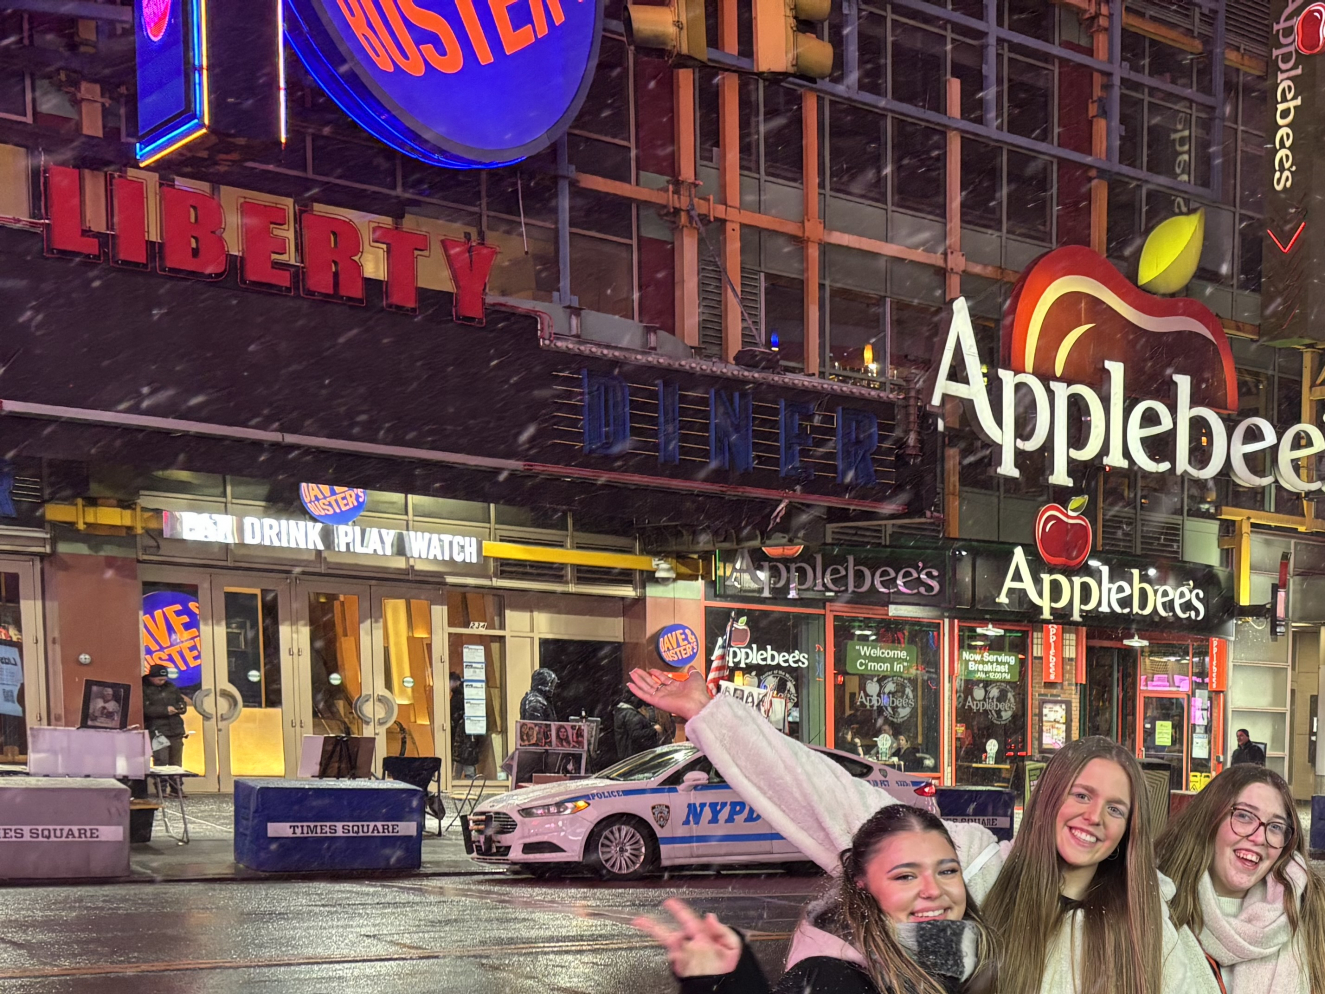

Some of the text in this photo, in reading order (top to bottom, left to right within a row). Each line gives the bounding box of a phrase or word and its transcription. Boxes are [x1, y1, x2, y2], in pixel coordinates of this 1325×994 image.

[44, 163, 499, 326] LIBERTY
[581, 368, 878, 488] DINER
[244, 518, 325, 551] DRINK
[336, 524, 397, 557] PLAY
[408, 530, 477, 563] WATCH
[725, 546, 941, 599] Applebee's
[996, 545, 1206, 622] Applebee's
[855, 645, 910, 660] "Welcome,
[962, 651, 1016, 665] Now Serving
[856, 659, 891, 672] C'mon
[968, 662, 1009, 673] Breakfast
[589, 788, 623, 800] POLICE
[681, 800, 762, 827] NYPD
[0, 827, 100, 840] ES SQUARE
[289, 823, 400, 836] TIMES SQUARE
